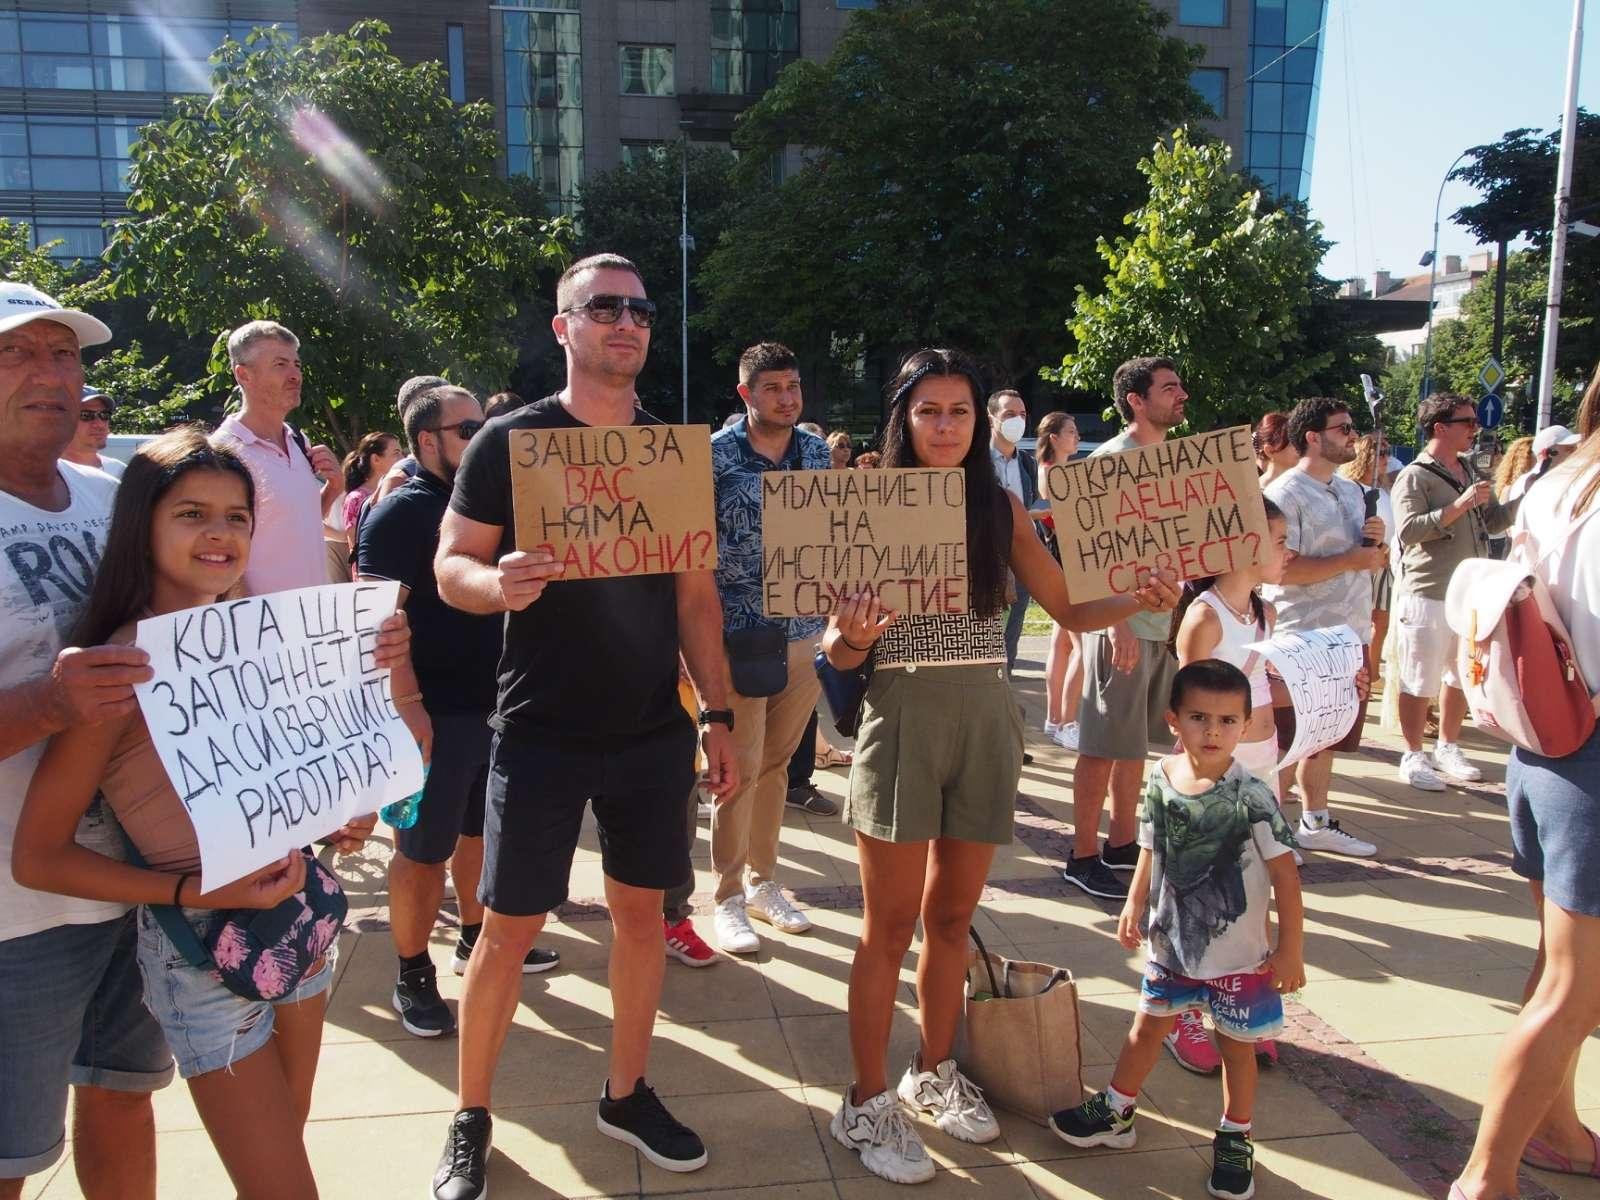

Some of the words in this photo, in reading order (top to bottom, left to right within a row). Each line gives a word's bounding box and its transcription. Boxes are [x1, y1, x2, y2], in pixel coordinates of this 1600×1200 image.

[517, 430, 627, 468] ЗАЩО
[638, 427, 684, 466] ЗА
[1047, 428, 1250, 502] ОТКРАДНАХТЕ
[564, 466, 636, 506] ВАС
[763, 471, 964, 510] МЪЛЧАНИЕТО
[1075, 492, 1108, 531] ОТ
[1115, 469, 1236, 525] ДЕЦАТА
[541, 501, 654, 540] НЯМА
[830, 510, 875, 543] НА
[1077, 514, 1195, 572] НЯМАТЕ
[1204, 503, 1244, 541] ЛИ
[763, 542, 966, 580] ИНСТИТУЦИИТЕ
[766, 582, 784, 615] Е
[174, 598, 284, 672] КОГА
[299, 586, 379, 639] ЩЕ
[151, 631, 380, 736] ЗАПОЧНЕТЕ
[236, 732, 398, 848] РАБОТАТА?
[1217, 991, 1236, 1006] THE
